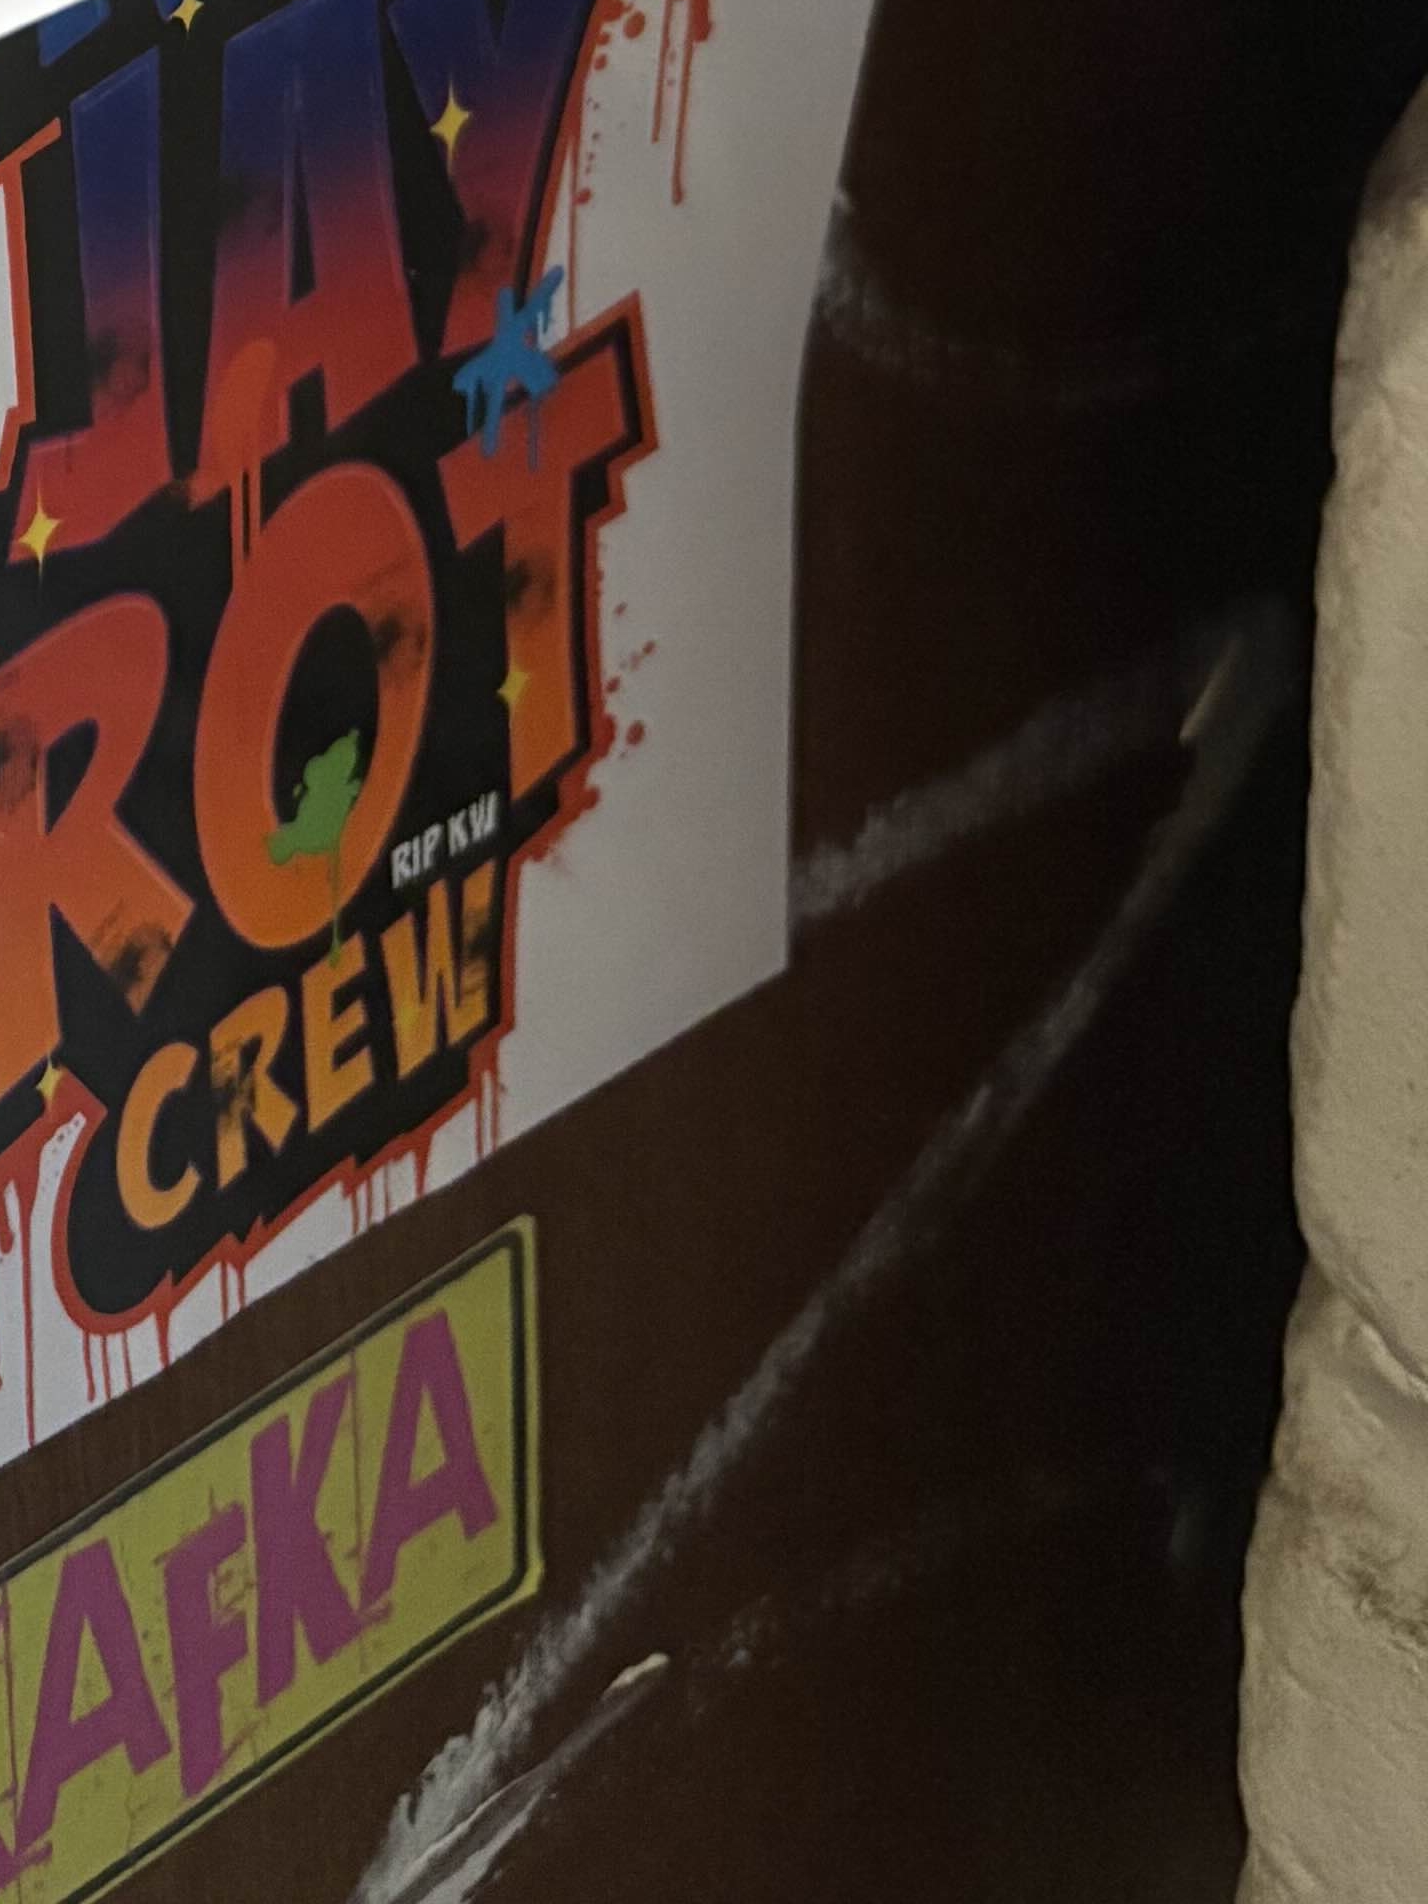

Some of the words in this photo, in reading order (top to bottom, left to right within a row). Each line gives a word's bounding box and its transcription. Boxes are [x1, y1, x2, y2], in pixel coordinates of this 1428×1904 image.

[391, 822, 445, 889] RIP
[448, 790, 500, 857] KW
[116, 859, 497, 1230] CREW
